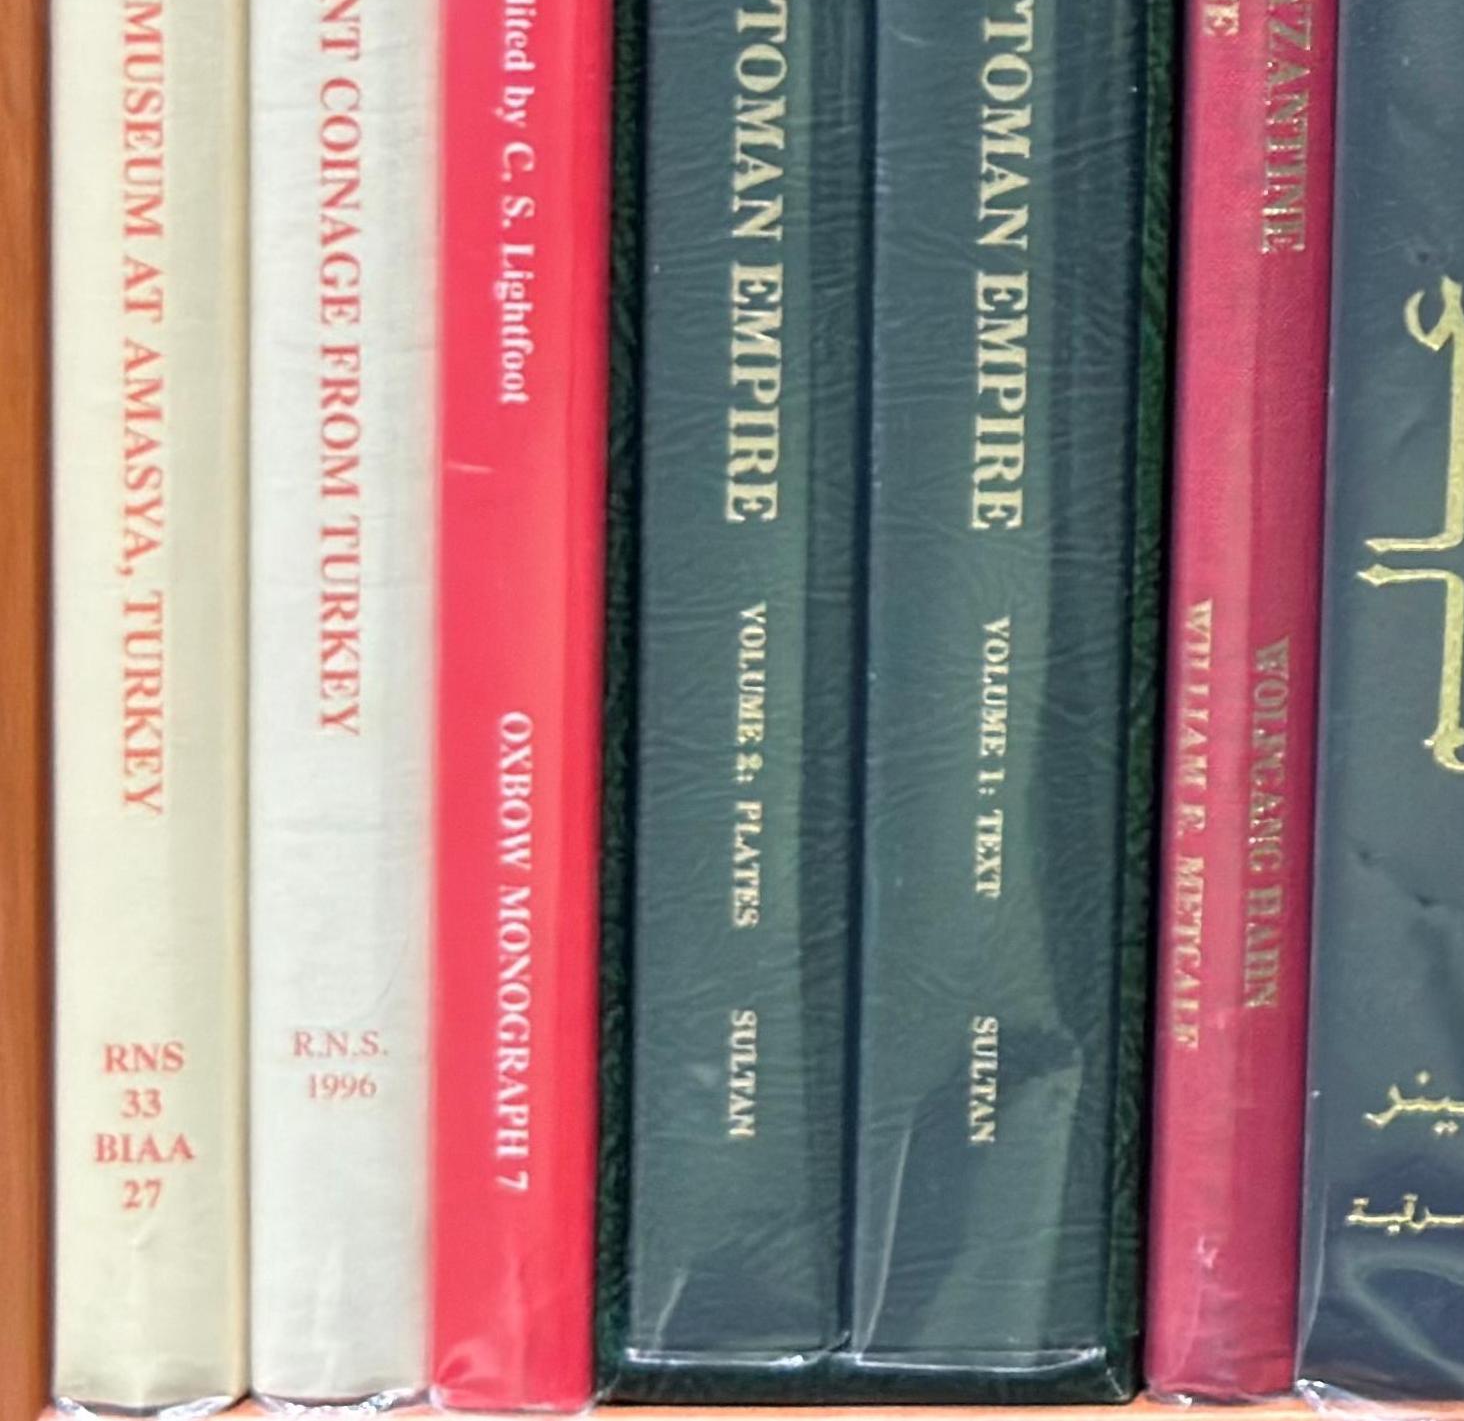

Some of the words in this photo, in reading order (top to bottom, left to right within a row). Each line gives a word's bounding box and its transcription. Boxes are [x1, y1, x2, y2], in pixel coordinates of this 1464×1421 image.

[122, 0, 164, 238] MUSEUM
[495, 84, 536, 129] by
[501, 142, 536, 181] C.
[319, 78, 361, 326] COINAGE
[501, 193, 536, 228] S.
[122, 255, 164, 323] AT
[492, 242, 535, 405] Lightfoot
[115, 336, 164, 577] AMASYA,
[319, 343, 361, 499] FROM
[725, 262, 784, 524] EMPIRE
[969, 271, 1029, 531] EMPIRE
[319, 514, 361, 737] TURKEY
[736, 601, 768, 747] VOLUME
[979, 616, 1011, 758] VOLUME
[121, 590, 164, 815] TURKEY
[1179, 599, 1214, 790] WILLIAM
[1246, 635, 1291, 874] WOLFGANG
[498, 711, 533, 872] OXBOW
[975, 809, 1005, 898] TEXT
[731, 799, 764, 929] PLATES
[1170, 856, 1206, 1050] METCALF
[1243, 883, 1285, 1010] HAHN
[103, 1041, 186, 1074] RNS
[293, 1030, 389, 1058] R.N.S.
[306, 1072, 378, 1100] 1996
[495, 884, 532, 1159] MONOGRAPH
[728, 1009, 758, 1139] SULTAN
[968, 1015, 999, 1145] SULTAN
[94, 1132, 196, 1163] BIAA
[120, 1088, 163, 1119] 33
[121, 1178, 163, 1210] 27
[495, 1170, 529, 1192] 7
